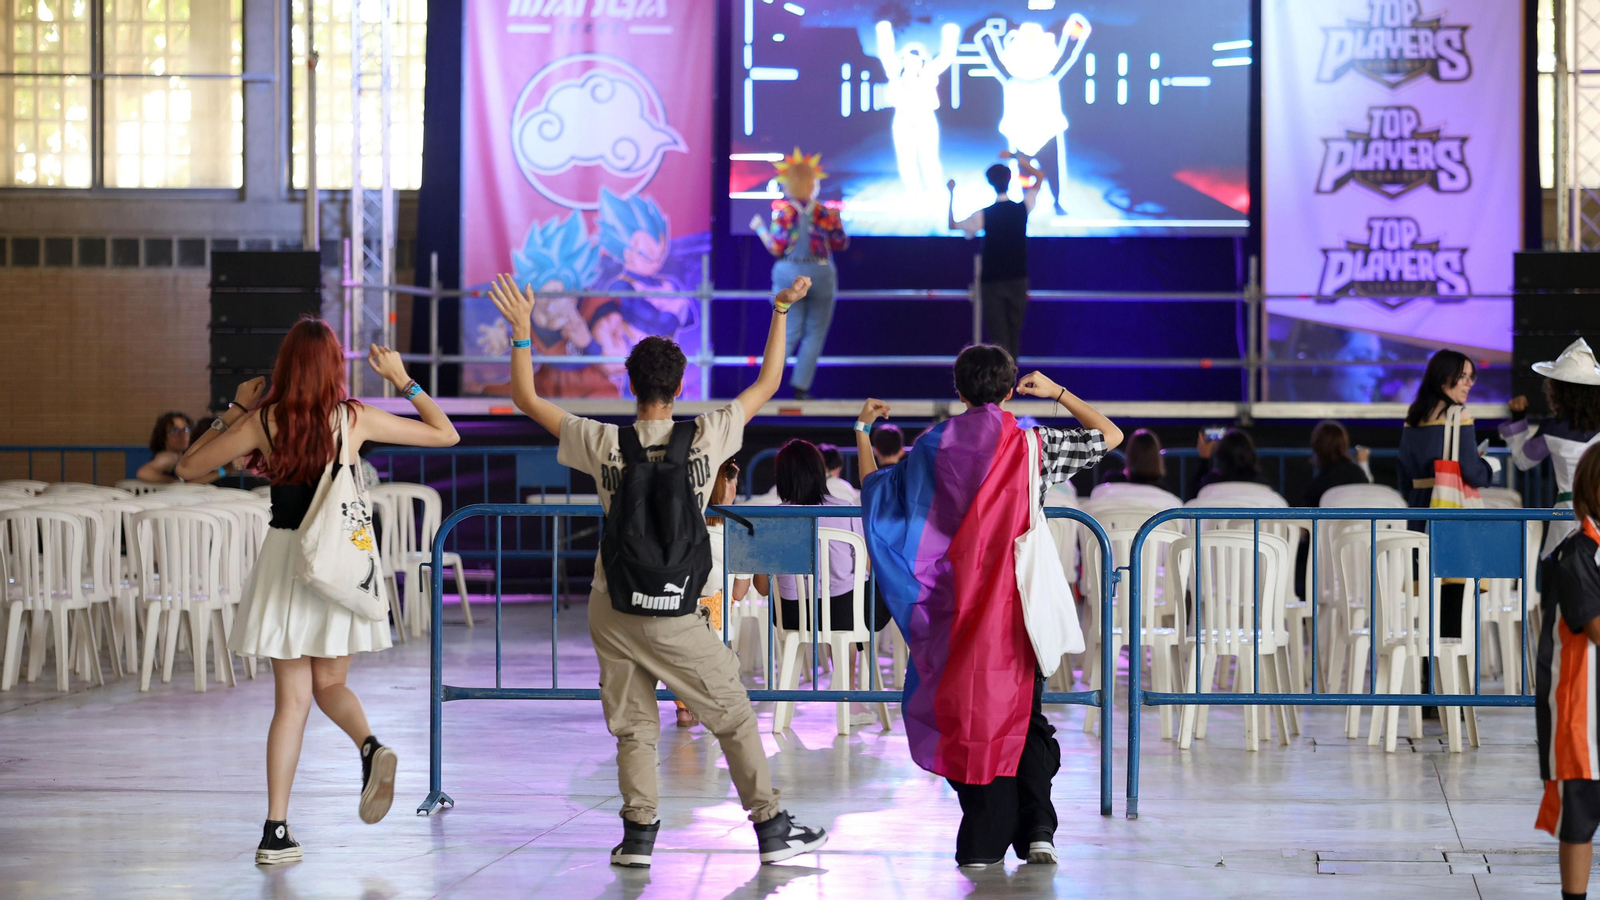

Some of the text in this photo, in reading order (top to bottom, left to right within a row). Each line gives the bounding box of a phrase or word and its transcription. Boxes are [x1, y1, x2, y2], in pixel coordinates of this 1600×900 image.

[1369, 0, 1418, 27] TOP
[1317, 27, 1472, 82] PLAYERS
[1369, 107, 1418, 139] TOP
[1317, 138, 1471, 193] PLAYERS
[1369, 217, 1418, 250] TOP
[1317, 249, 1471, 301] PLAYERS
[631, 591, 681, 610] PUMA
